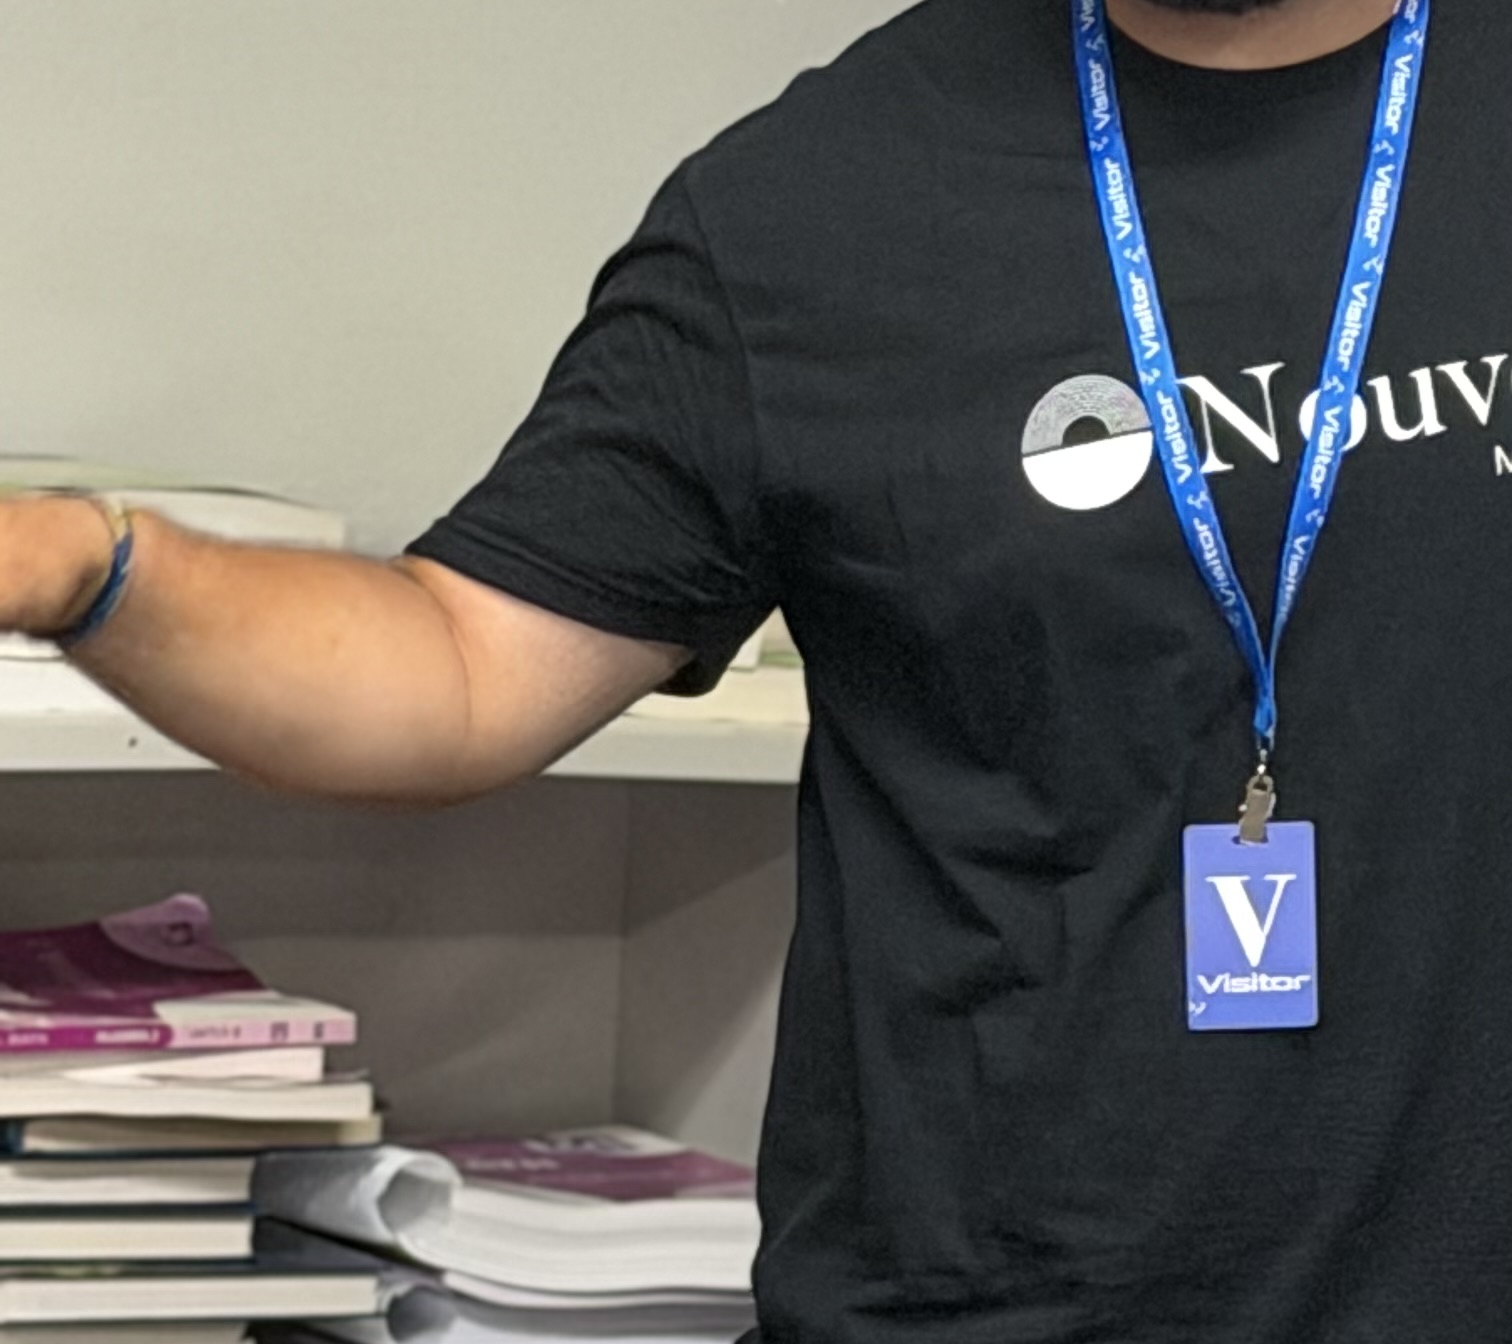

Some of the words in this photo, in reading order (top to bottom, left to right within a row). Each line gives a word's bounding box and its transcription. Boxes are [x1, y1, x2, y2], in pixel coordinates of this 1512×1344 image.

[1088, 58, 1112, 131] Visitor
[1385, 53, 1414, 136] Visitor
[1104, 158, 1133, 241] Visitor
[1363, 163, 1396, 248] Visitor
[1128, 270, 1161, 361] Visitor
[1336, 280, 1373, 373] Visitor
[1155, 388, 1193, 485] Visitor
[1309, 404, 1343, 501] Visitor
[1192, 516, 1237, 608] Visitor
[1204, 873, 1298, 969] V
[1196, 971, 1312, 995] Visitor
